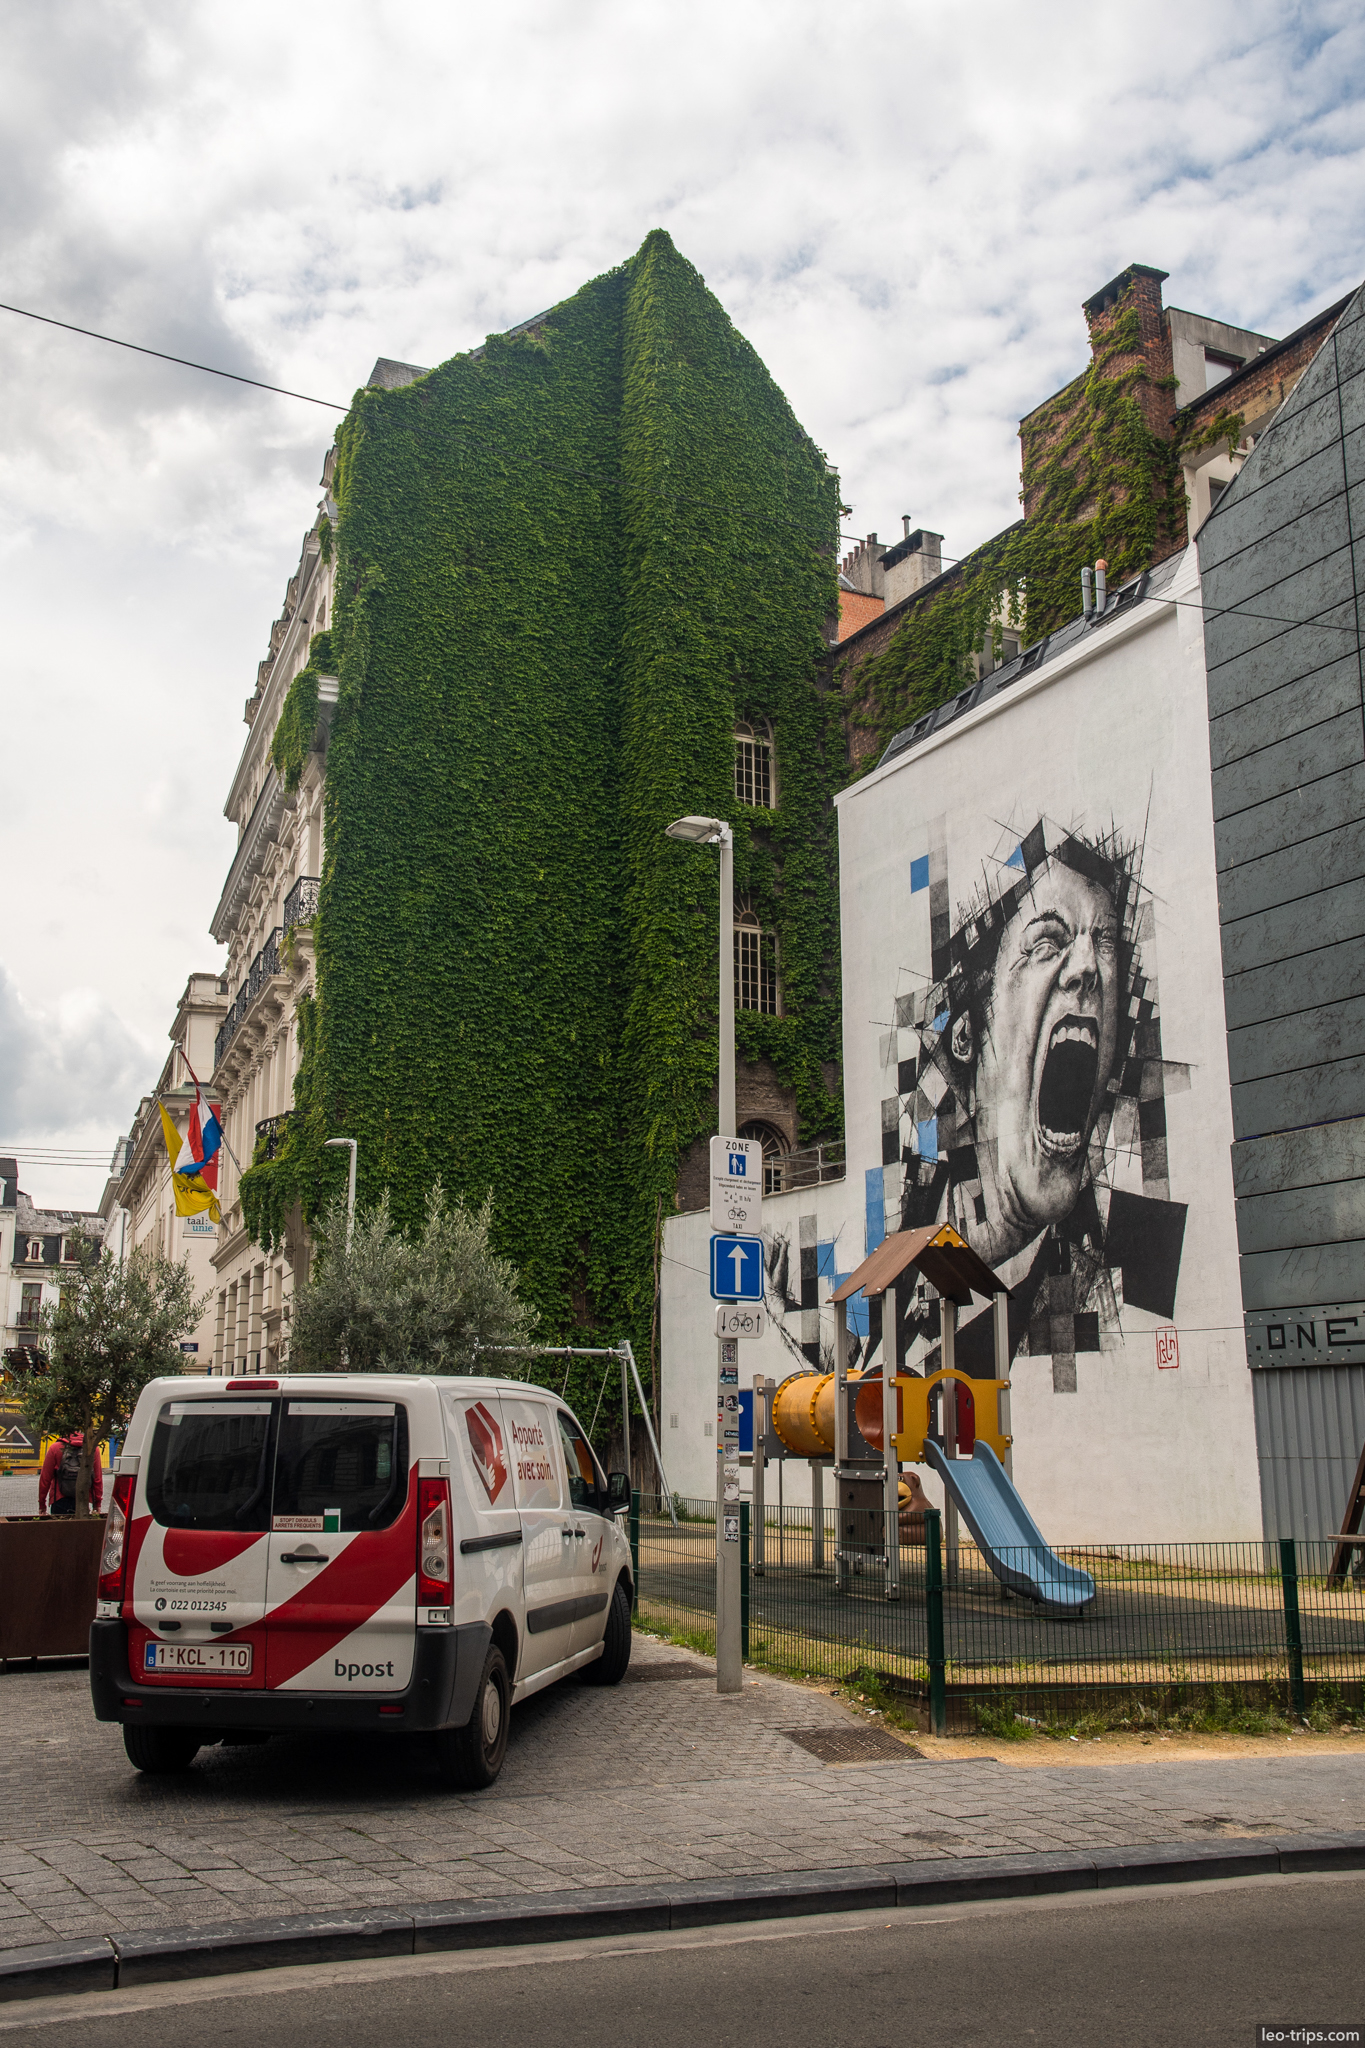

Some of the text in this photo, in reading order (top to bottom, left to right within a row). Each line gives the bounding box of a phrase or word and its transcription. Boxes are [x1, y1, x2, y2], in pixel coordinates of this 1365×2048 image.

[726, 1141, 749, 1152] ZONE
[187, 1217, 208, 1225] taal:
[511, 1420, 544, 1452] Apporté
[517, 1455, 554, 1481] avec soin.
[171, 1601, 227, 1611] 022 012345
[148, 1656, 154, 1664] B
[335, 1659, 394, 1681] bpost
